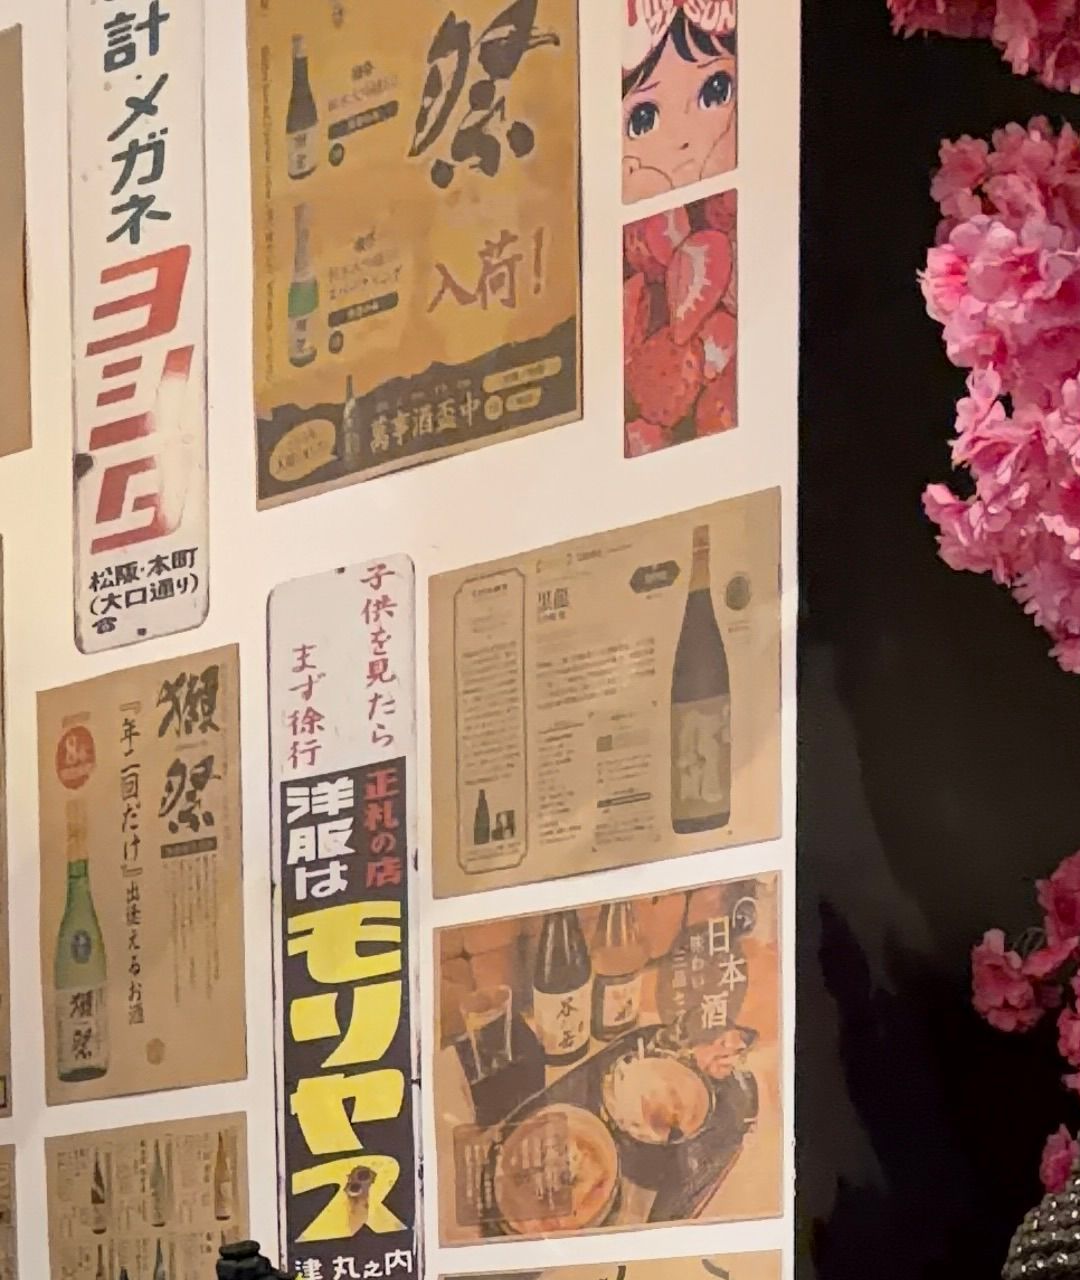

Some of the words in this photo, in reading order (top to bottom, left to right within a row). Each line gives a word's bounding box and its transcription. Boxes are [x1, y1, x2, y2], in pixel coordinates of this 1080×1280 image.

[288, 643, 326, 769] まず徐行
[360, 563, 397, 748] 子供を見たら
[286, 776, 356, 900] 洋服は
[363, 768, 401, 889] 正札の店
[701, 915, 747, 1030] 日本酒
[287, 900, 408, 1243] モリヤス
[332, 1249, 413, 1280] 丸之内
